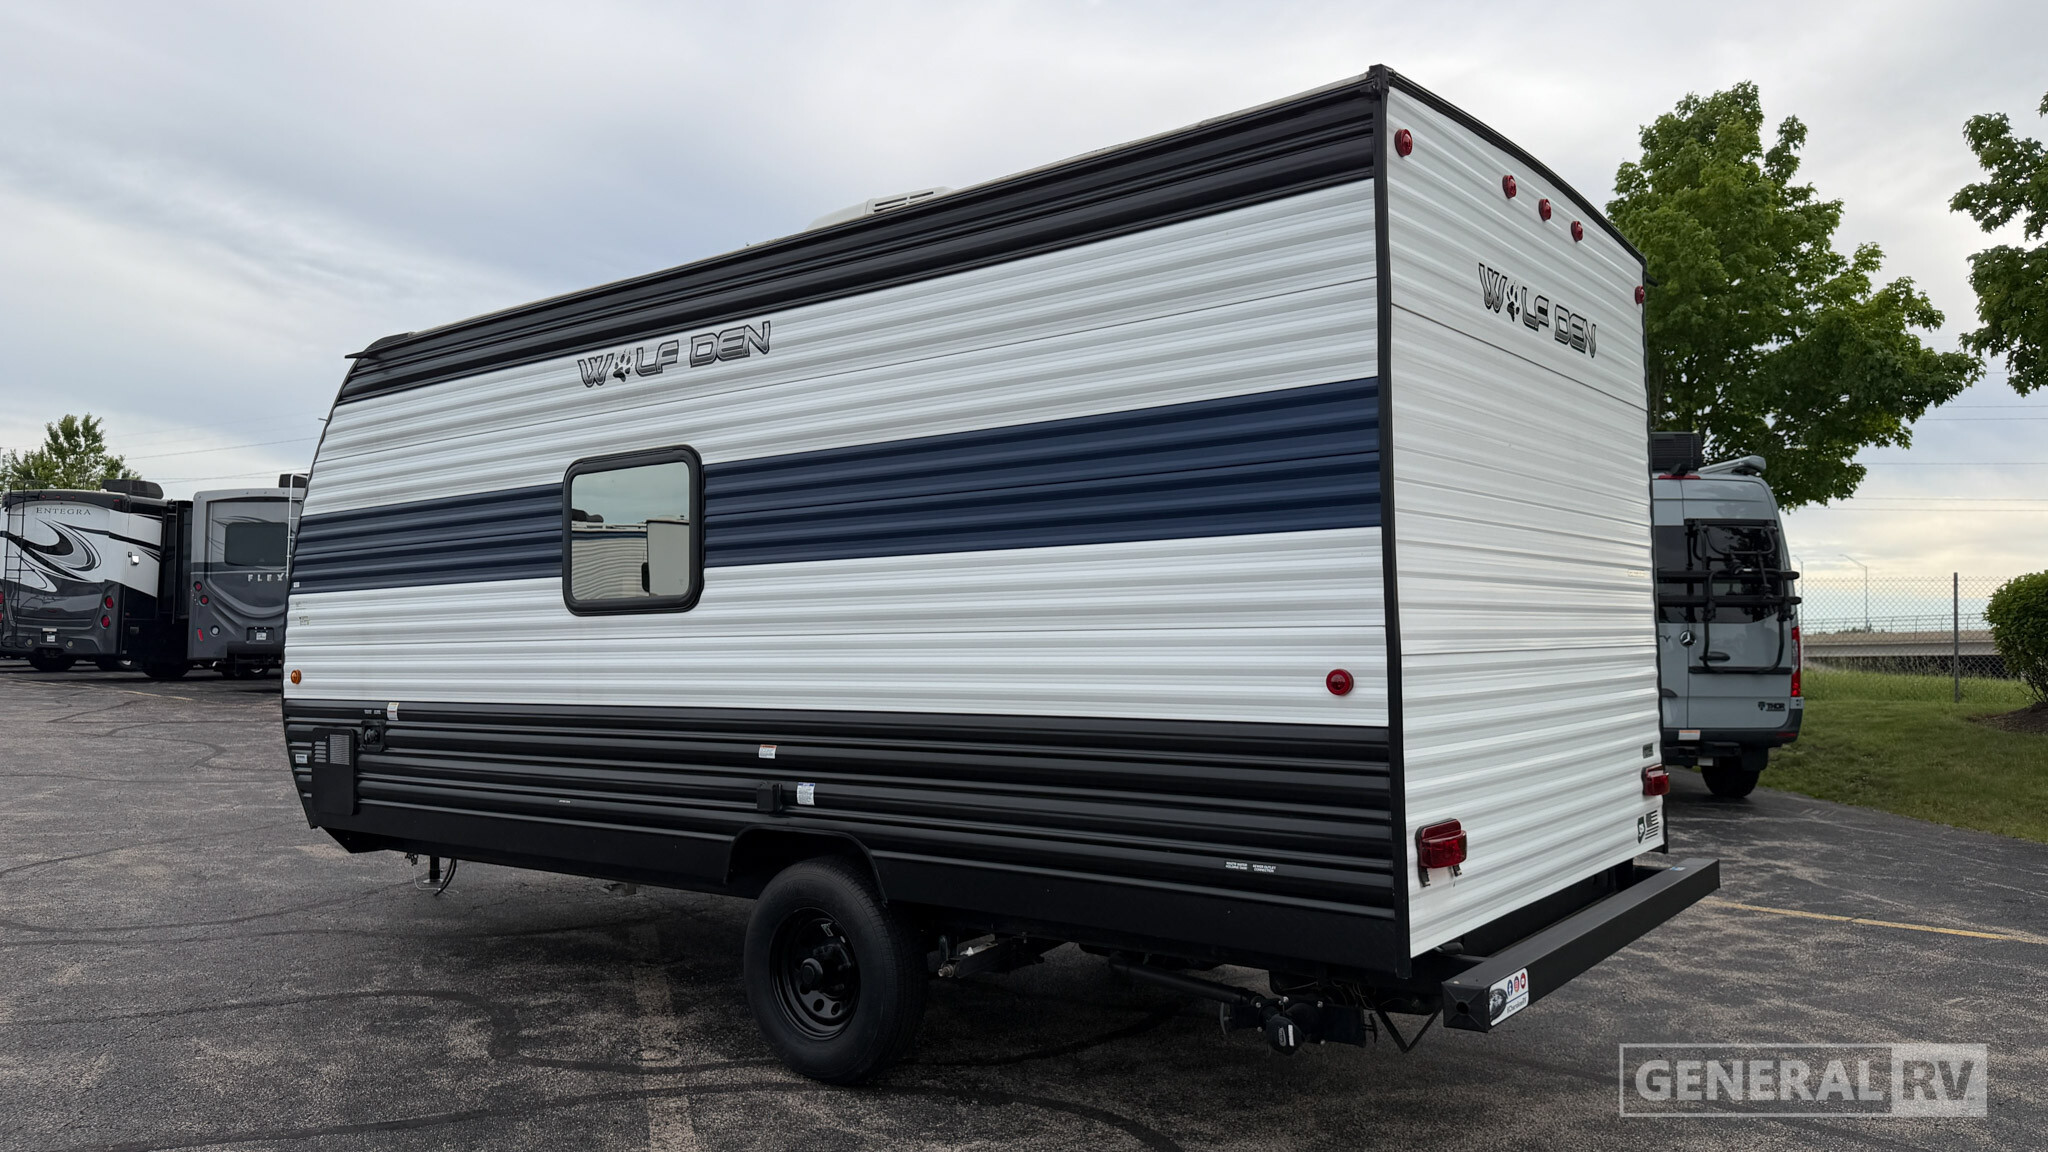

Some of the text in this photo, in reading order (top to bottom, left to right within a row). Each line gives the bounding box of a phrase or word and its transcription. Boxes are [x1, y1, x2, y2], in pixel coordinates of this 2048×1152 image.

[690, 320, 771, 368] DEN
[1555, 304, 1597, 359] DEN
[36, 507, 91, 515] ENTEGRA
